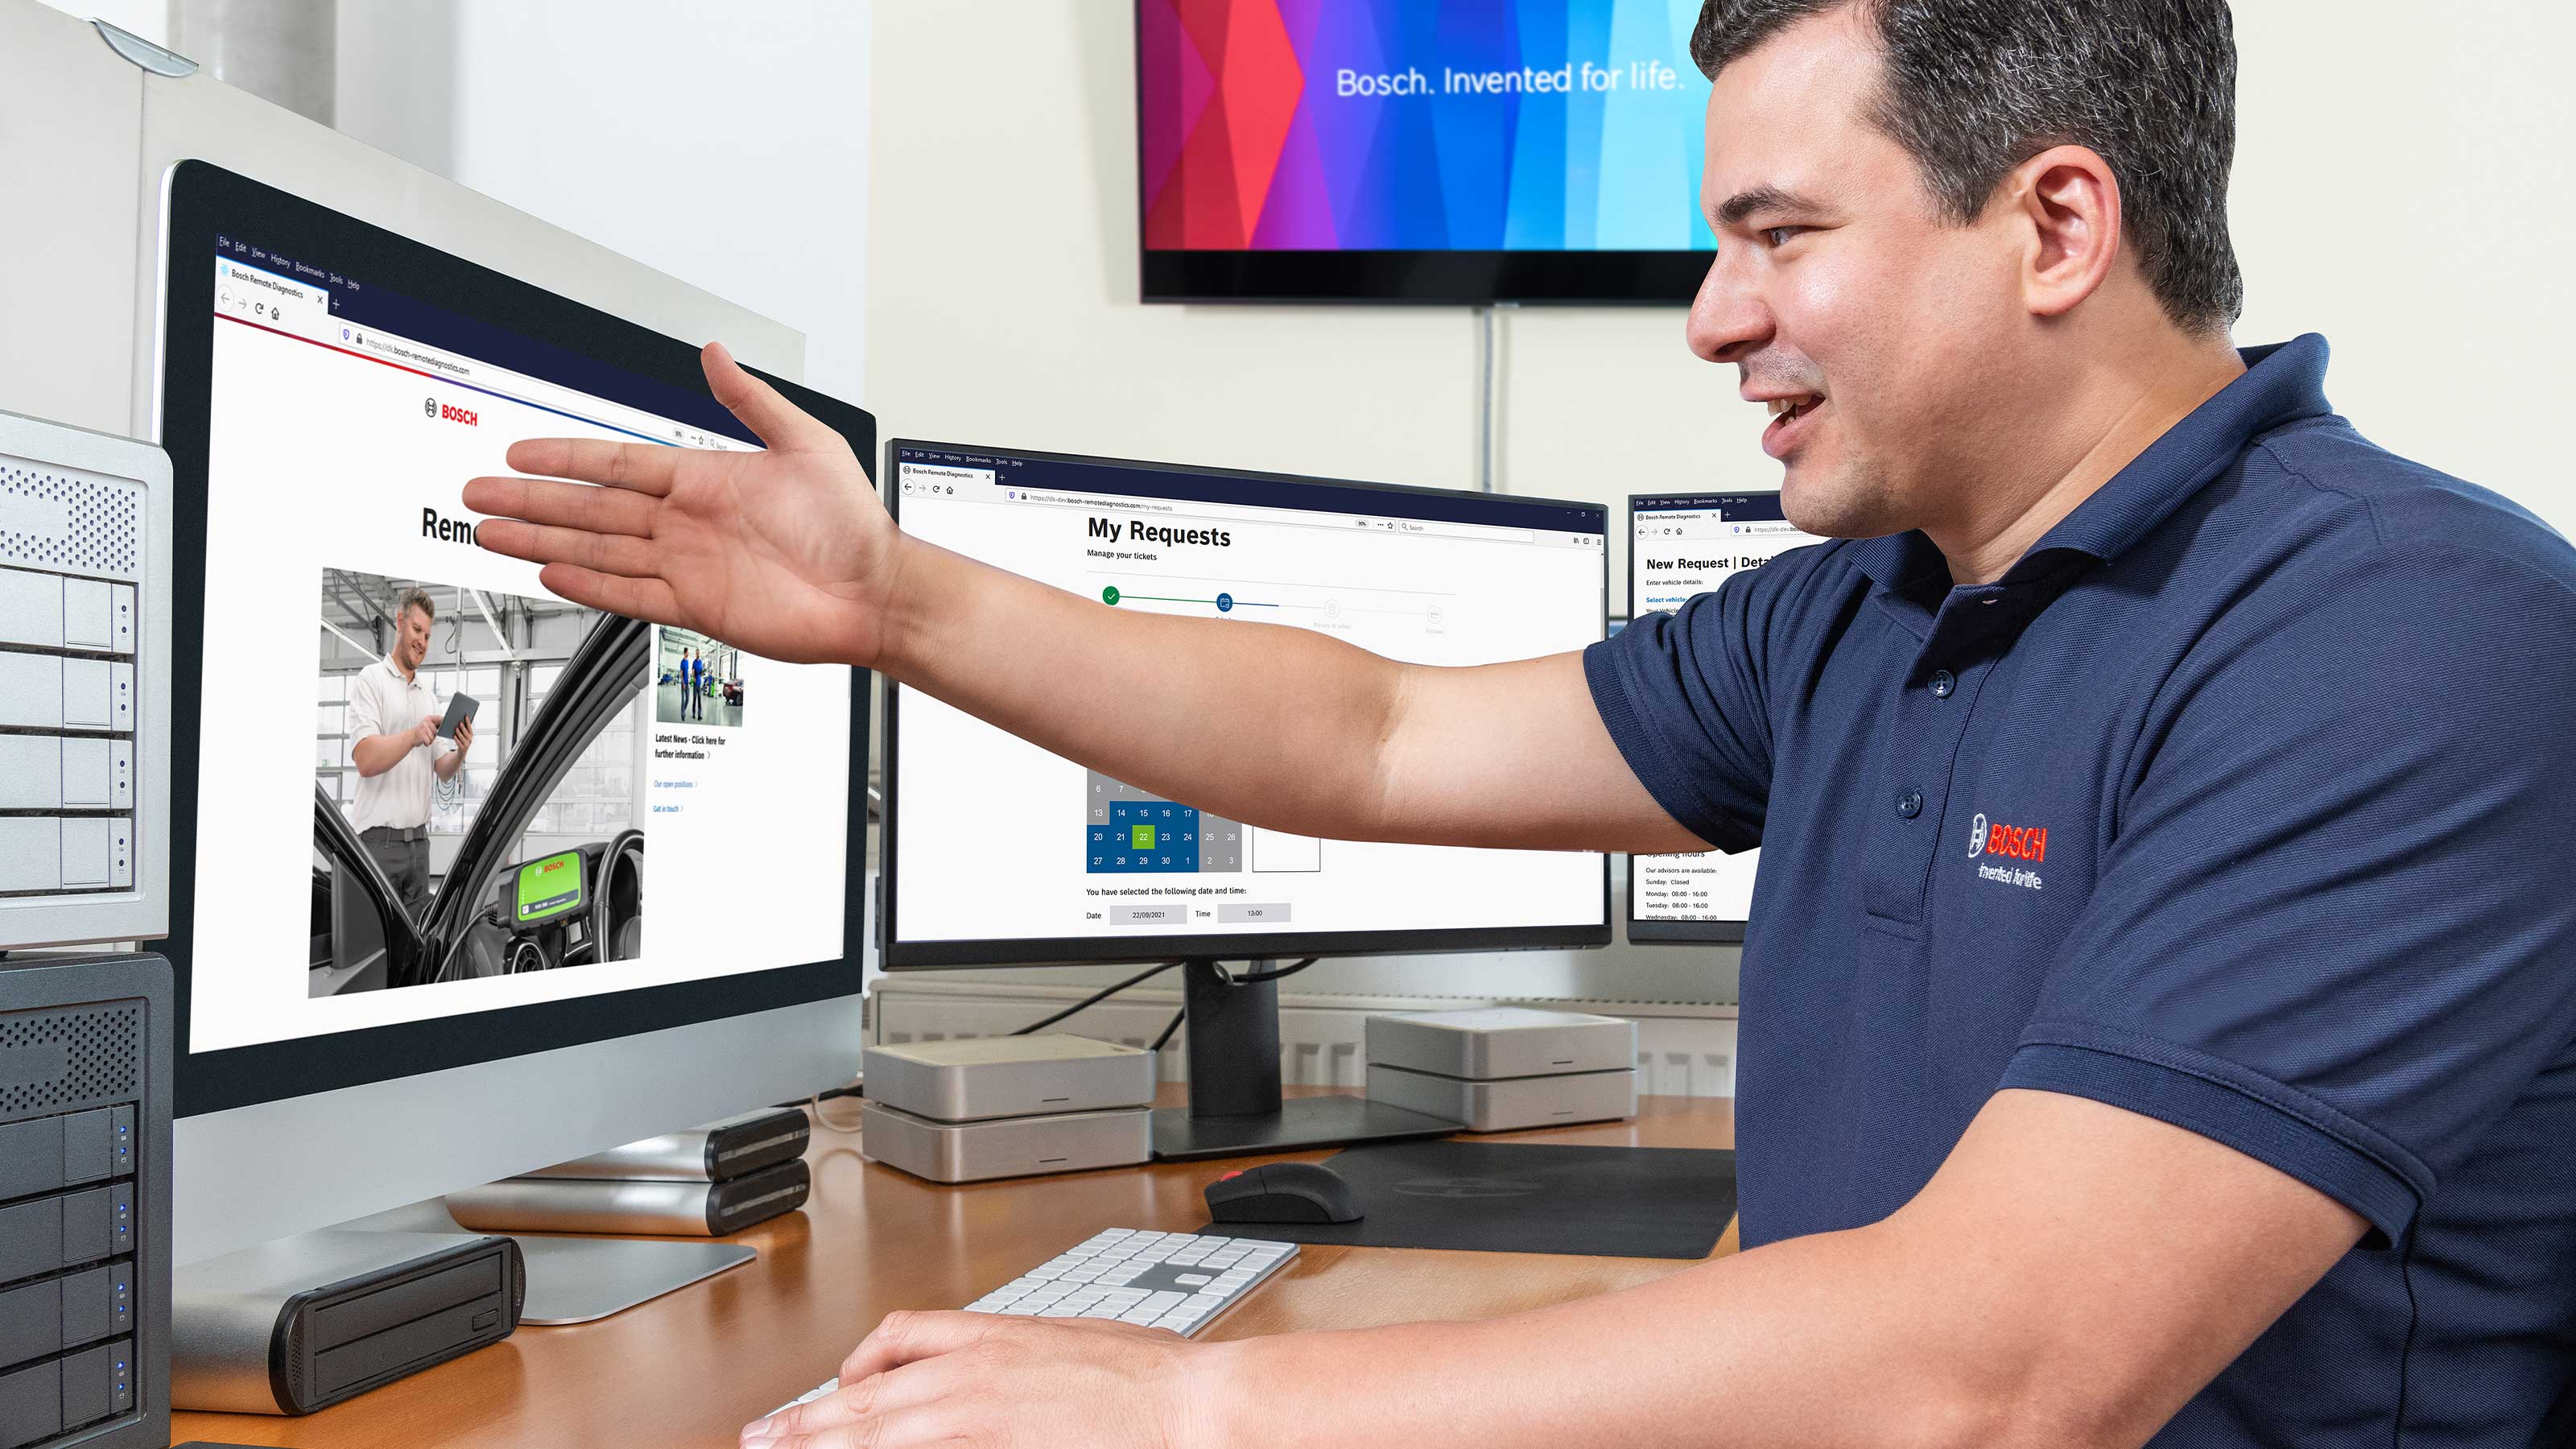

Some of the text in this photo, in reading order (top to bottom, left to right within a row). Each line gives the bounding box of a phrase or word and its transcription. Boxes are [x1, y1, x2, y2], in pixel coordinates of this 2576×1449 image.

[1336, 60, 1685, 97] Bosch. Invented for life.
[219, 237, 360, 291] File Edit View History Bookmarks Tools Help
[232, 269, 303, 299] Bosch Remote Diagnostics
[442, 404, 477, 427] BOSCH
[944, 454, 961, 462] History
[947, 471, 973, 479] Diagnostics
[1088, 517, 1231, 547] My Requests
[1087, 549, 1158, 560] Manage your tickets
[1646, 559, 1674, 570] New
[1678, 558, 1728, 571] Request
[655, 734, 672, 743] Latest
[673, 735, 687, 744] News
[691, 736, 704, 745] Click
[706, 737, 717, 745] here
[655, 749, 704, 759] further information
[654, 780, 693, 789] Our open positions
[1096, 785, 1124, 793] 6 7
[1094, 809, 1103, 817] 13
[1117, 809, 1125, 817] 14
[1140, 809, 1148, 817] 15
[1162, 809, 1170, 817] 16
[1184, 809, 1191, 817] 17
[1094, 833, 1236, 841] 20 21 22 23 24 25 26
[1985, 824, 2048, 863] BOSCH
[1094, 857, 1103, 865] 27
[1117, 857, 1125, 865] 28
[1139, 857, 1148, 865] 29
[1162, 857, 1170, 865] 30
[1208, 857, 1212, 865] 2
[1229, 857, 1234, 865] 3
[544, 861, 564, 873] BOSCH
[1101, 888, 1117, 896] have
[1120, 887, 1150, 896] selected
[1151, 887, 1162, 895] the
[1165, 887, 1196, 896] following
[1198, 887, 1213, 895] date
[1215, 886, 1228, 894] and
[1229, 886, 1247, 894] time:
[1087, 911, 1101, 920] Date
[1133, 910, 1165, 919] 22/09/2021
[1195, 910, 1211, 918] Time
